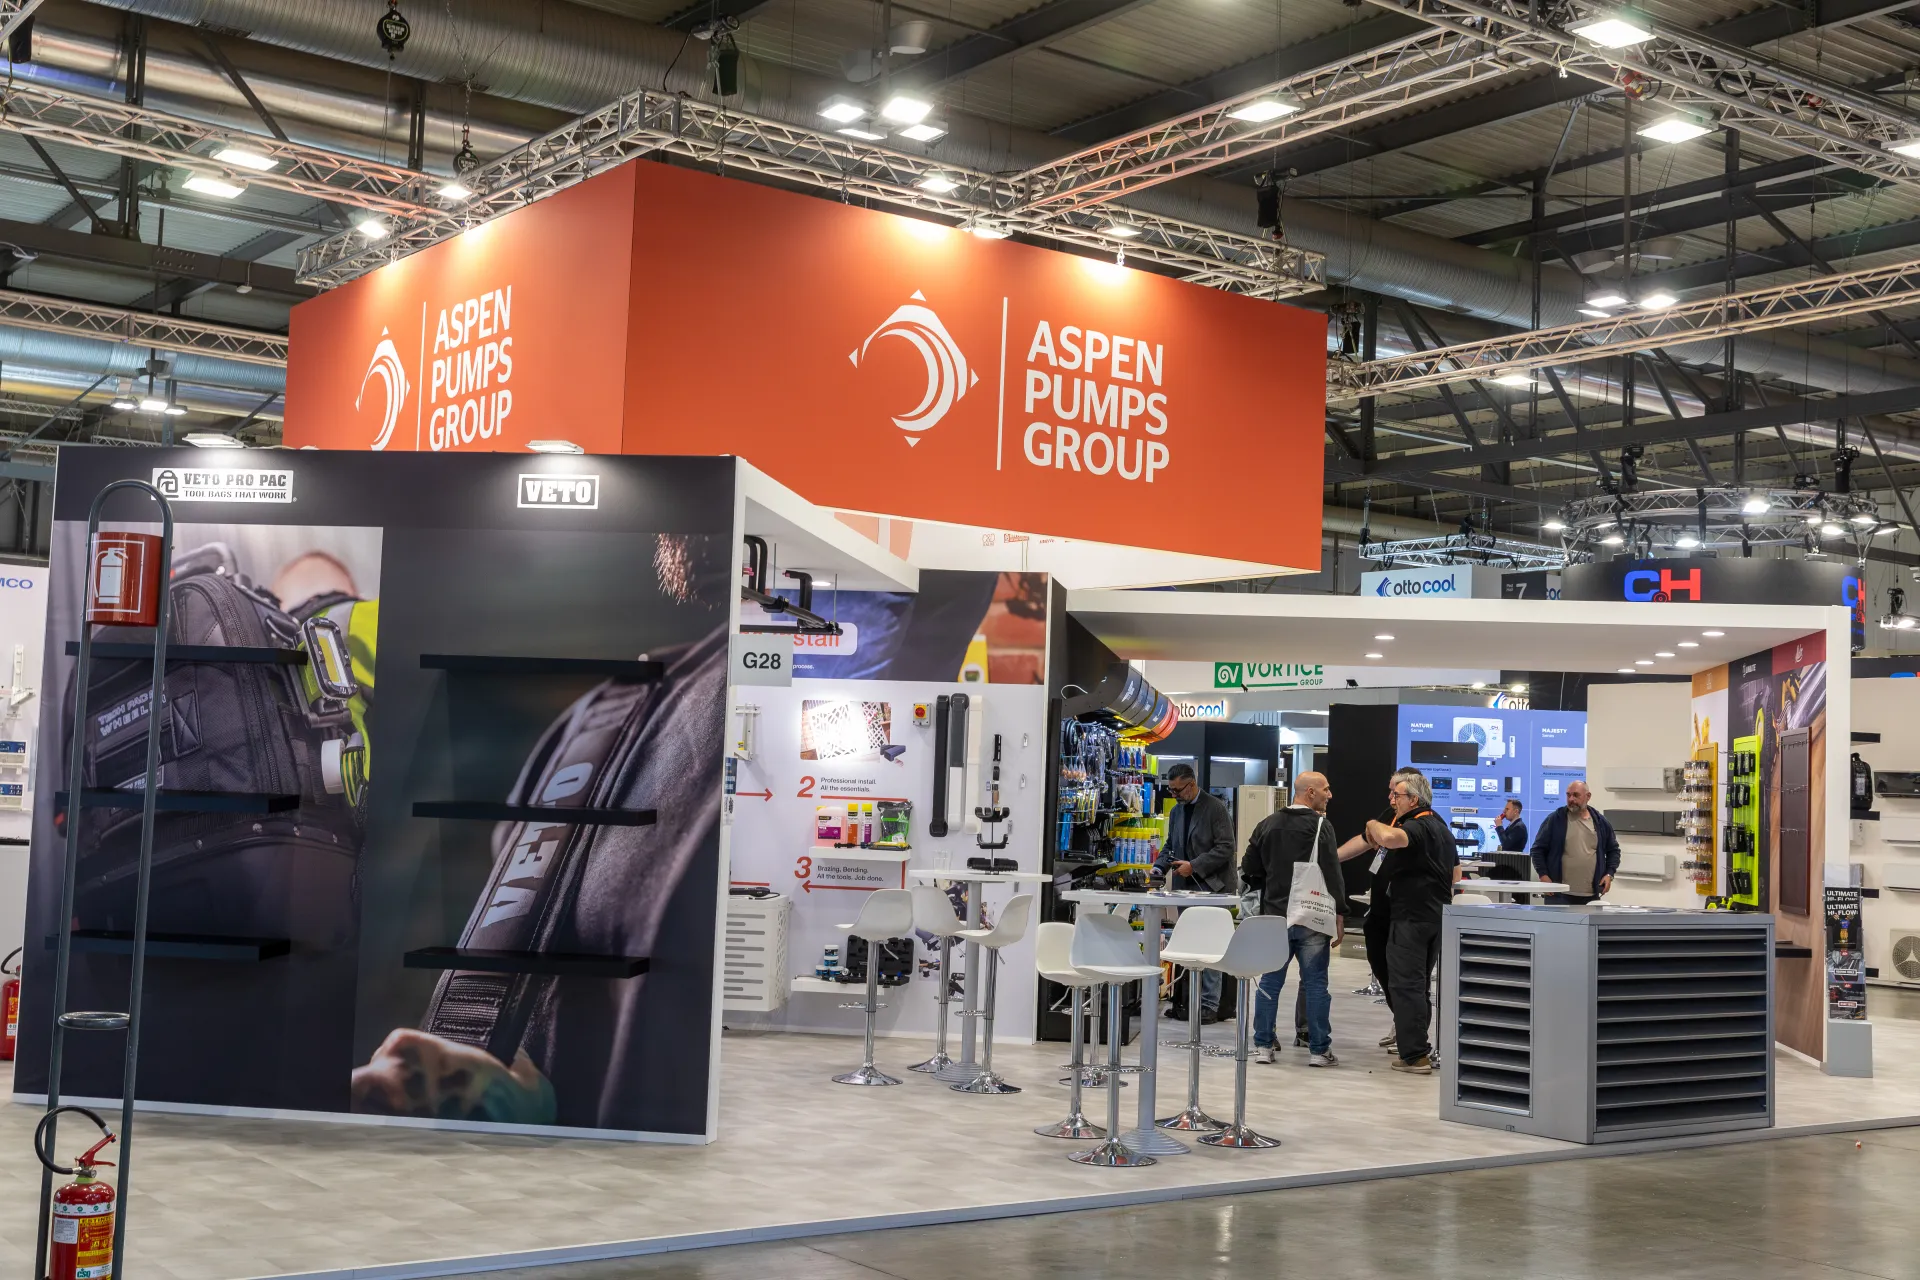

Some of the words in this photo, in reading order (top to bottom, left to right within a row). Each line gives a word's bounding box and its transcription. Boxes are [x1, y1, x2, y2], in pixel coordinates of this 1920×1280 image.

[433, 284, 512, 354] ASPEN
[1027, 320, 1164, 386] ASPEN
[431, 336, 513, 404] PUMPS
[1025, 369, 1168, 436] PUMPS
[429, 389, 513, 452] GROUP
[1023, 422, 1170, 483] GROUP
[184, 472, 220, 485] VETO
[226, 474, 254, 486] PRO
[259, 474, 287, 487] PAC
[184, 490, 206, 498] TOOL
[208, 490, 232, 498] BAGS
[235, 491, 257, 499] THAT
[259, 491, 287, 499] WORK
[525, 480, 592, 503] VETO
[1516, 583, 1528, 600] 7
[743, 652, 782, 670] G28
[1300, 679, 1324, 687] GROUP
[797, 775, 816, 798] 2
[794, 856, 813, 879] 3
[1300, 900, 1325, 908] DRIVING
[1826, 890, 1859, 898] ULTIMATE
